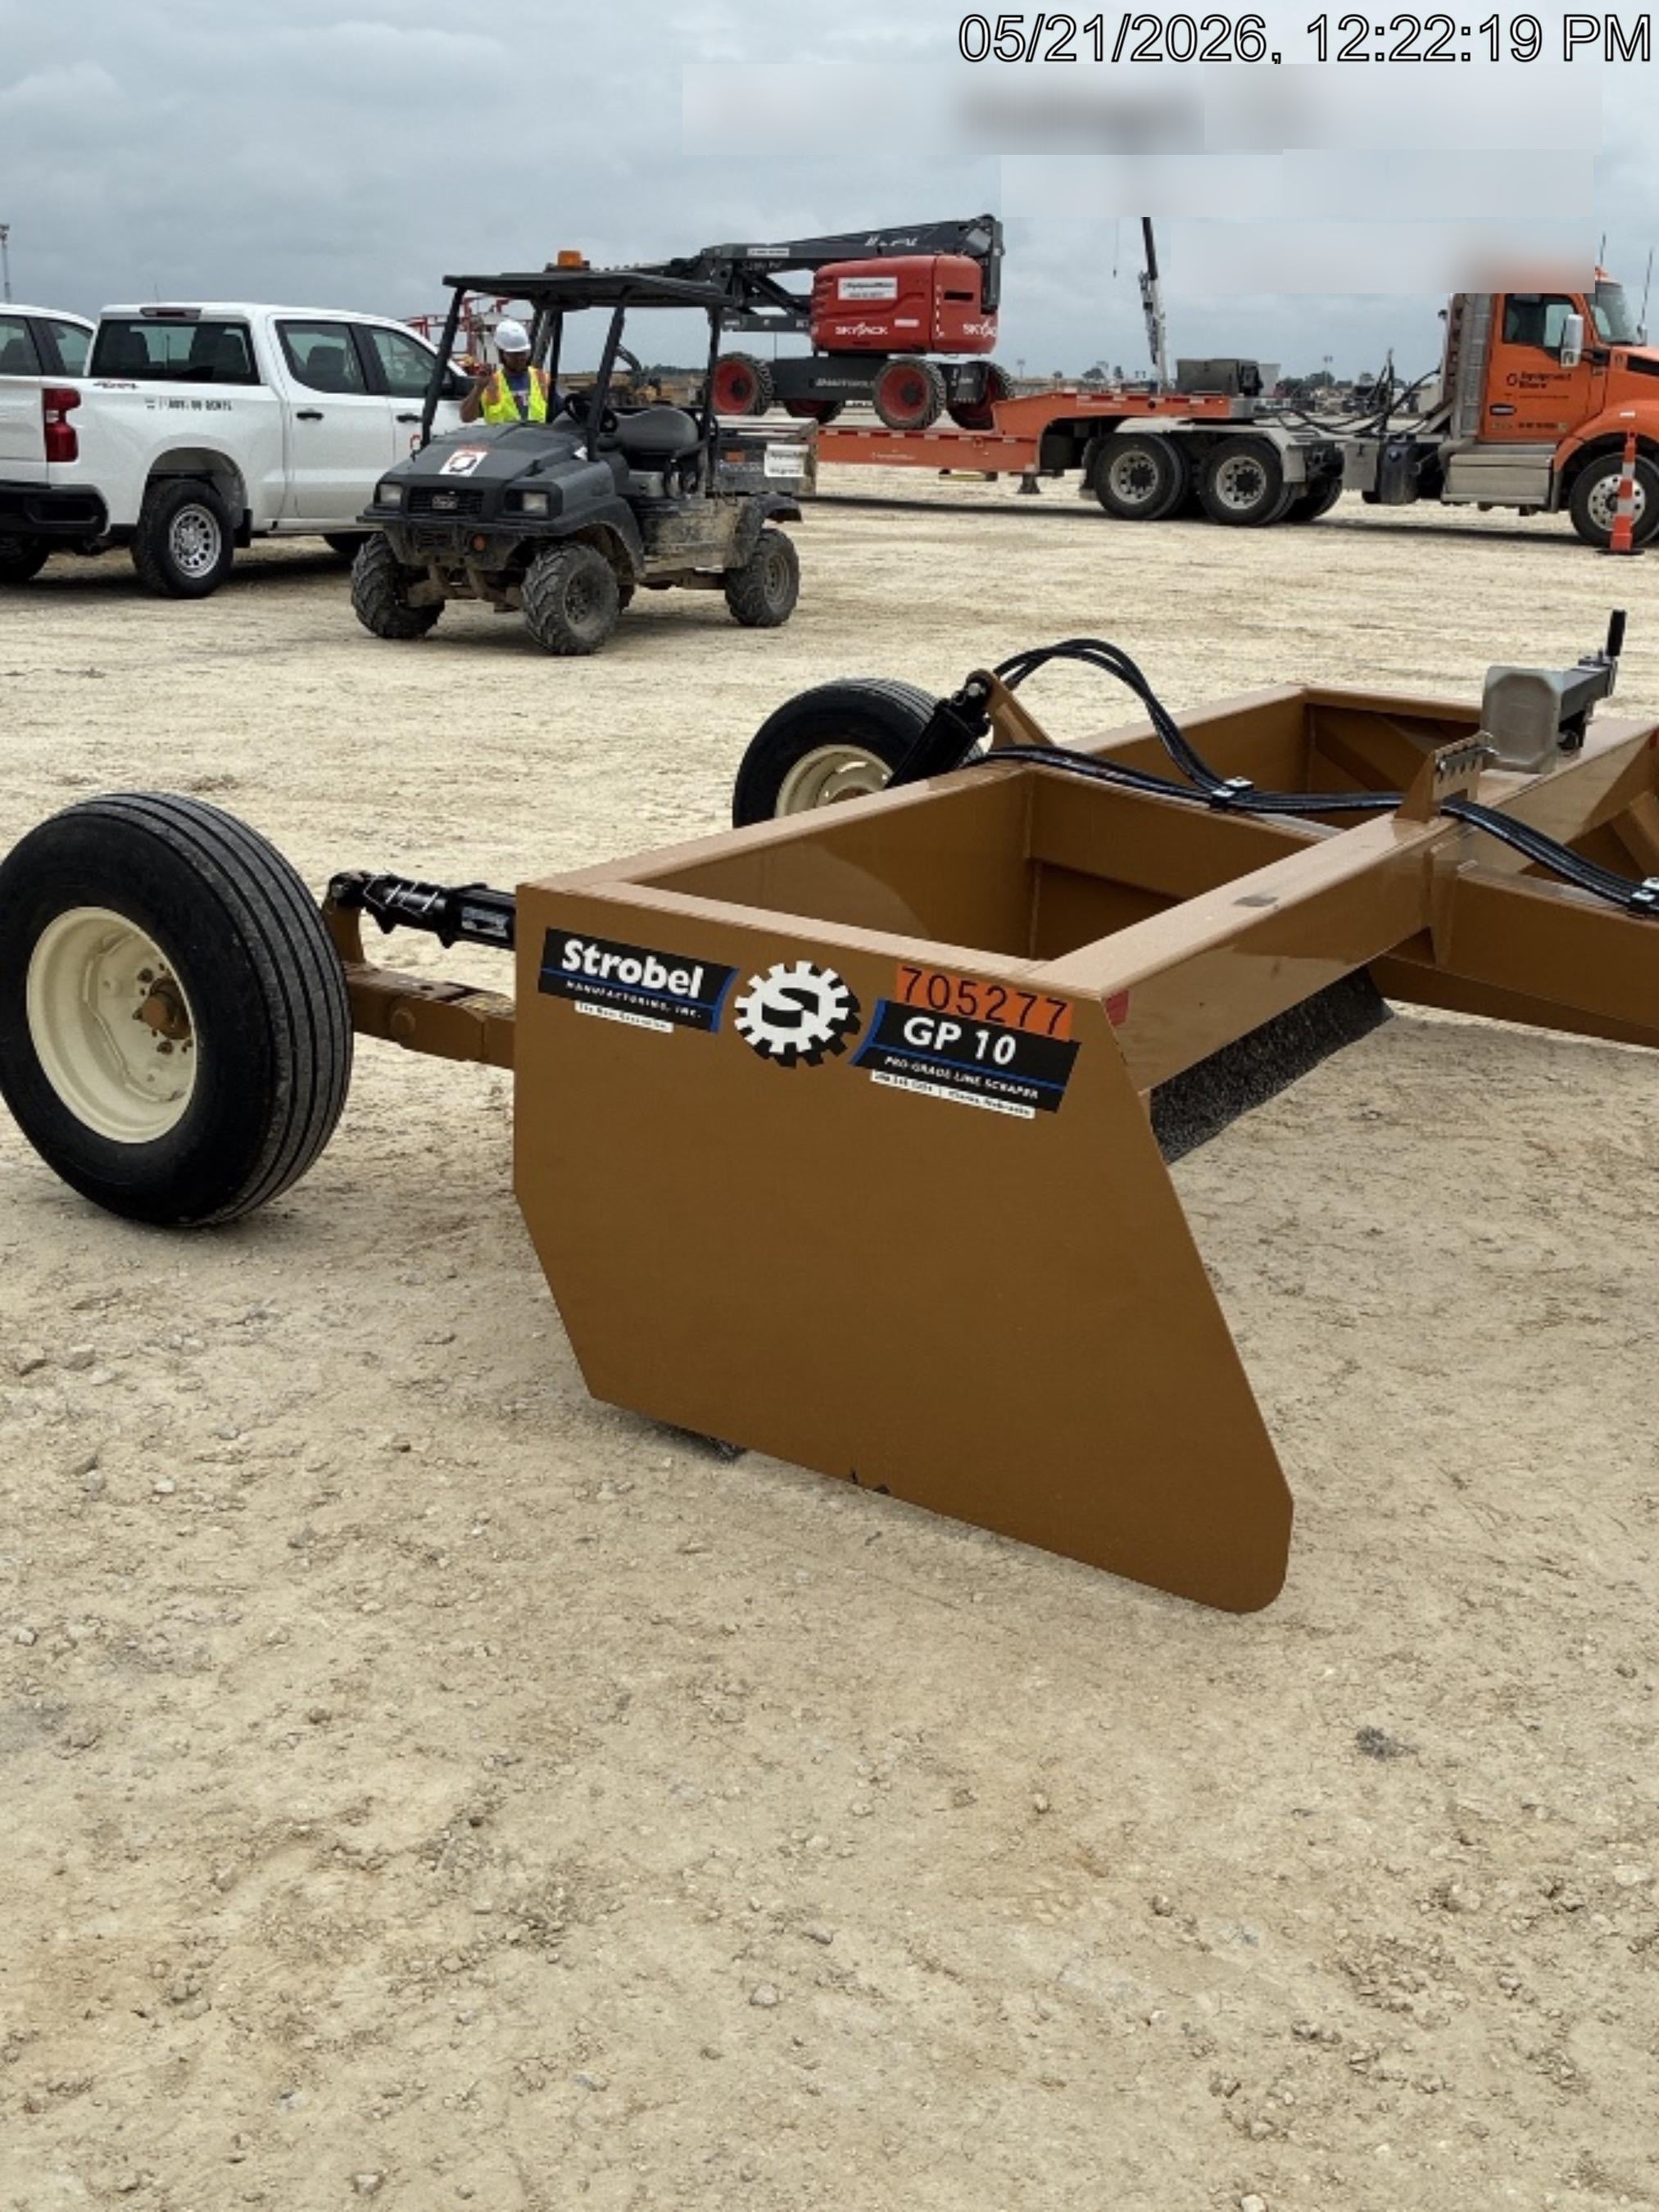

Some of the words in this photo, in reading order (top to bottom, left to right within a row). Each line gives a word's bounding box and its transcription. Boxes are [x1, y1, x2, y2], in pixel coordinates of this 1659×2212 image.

[835, 320, 889, 338] SKYJACK
[962, 317, 997, 338] SKYJAC
[562, 938, 704, 999] Strobel
[902, 967, 1067, 1036] 705277
[903, 1016, 963, 1051] GP
[975, 1028, 1017, 1066] 10
